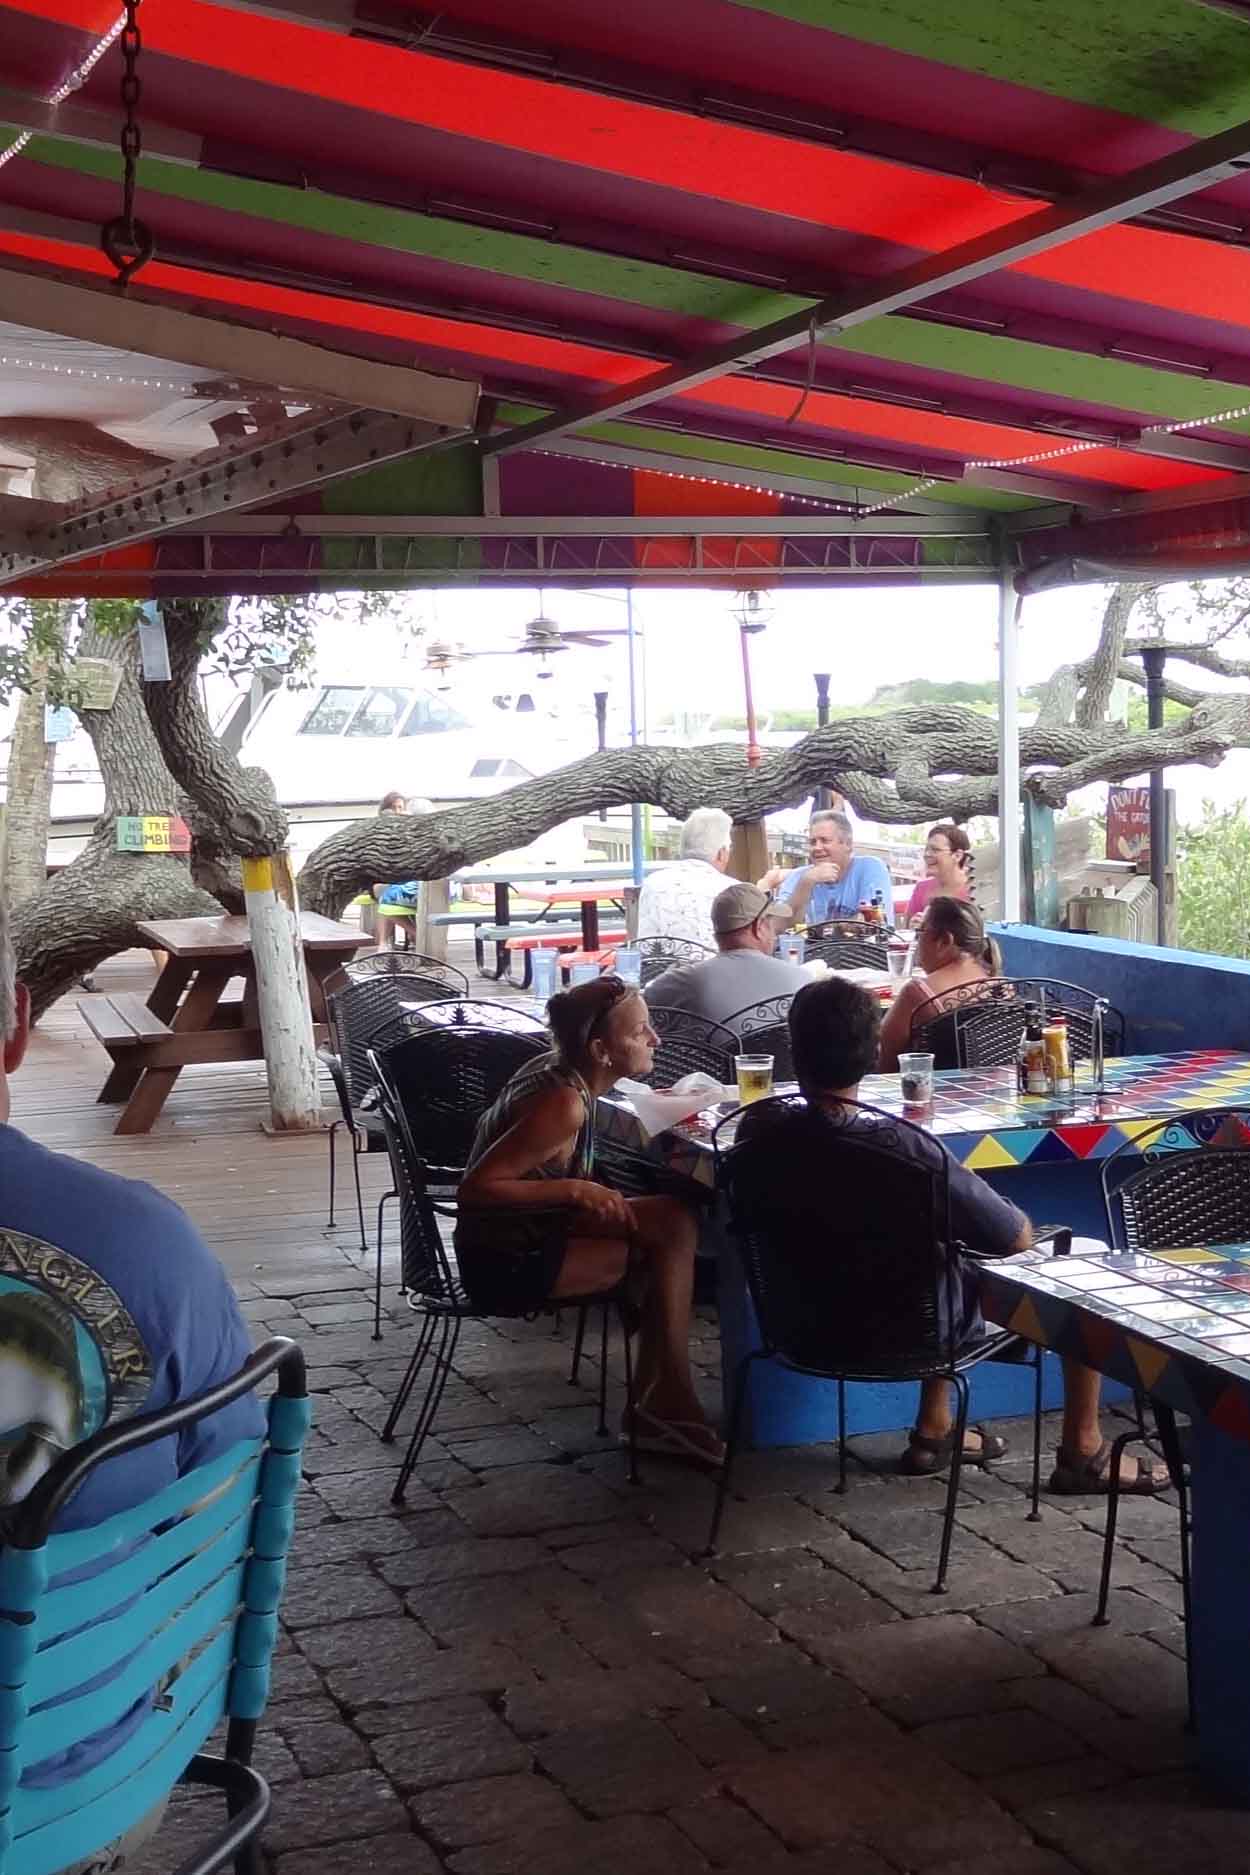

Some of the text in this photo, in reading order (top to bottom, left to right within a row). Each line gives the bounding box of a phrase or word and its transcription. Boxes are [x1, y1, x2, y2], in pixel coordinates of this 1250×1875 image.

[128, 822, 176, 832] NO TREE
[0, 1236, 144, 1381] NGLER
